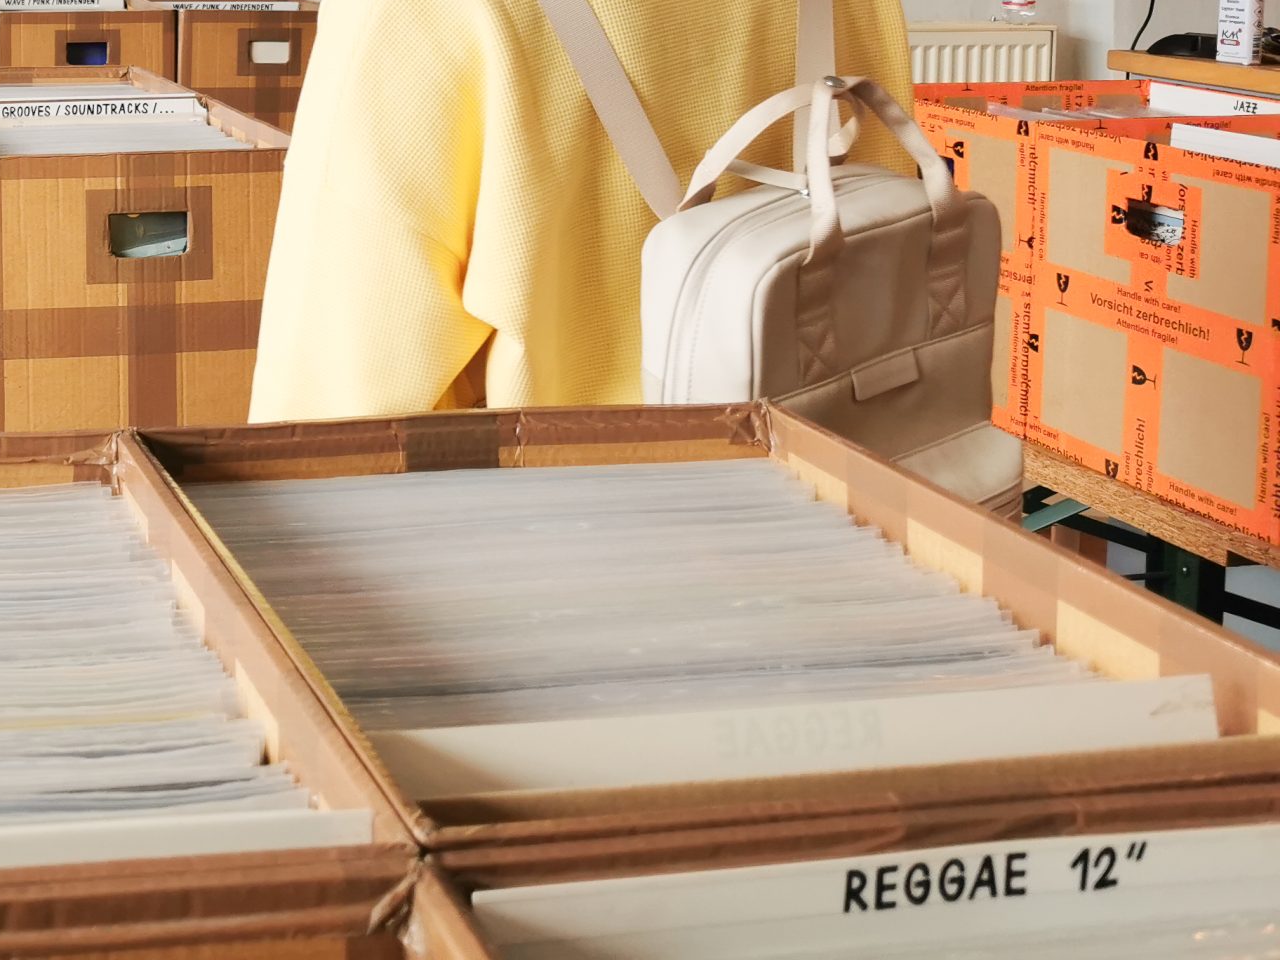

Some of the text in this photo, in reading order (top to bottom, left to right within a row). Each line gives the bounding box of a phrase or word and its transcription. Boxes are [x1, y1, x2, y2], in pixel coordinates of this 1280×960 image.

[4, 0, 25, 7] WAVE
[1059, 84, 1084, 92] fragile!
[1, 105, 51, 119] GROOVES
[64, 103, 149, 117] SOUNDTRACKS
[1233, 100, 1258, 114] JAZZ
[1204, 121, 1232, 129] fragile!
[1055, 136, 1070, 145] with
[1071, 139, 1095, 152] Handle
[1212, 168, 1234, 179] care!
[1234, 171, 1253, 183] with
[1189, 219, 1198, 279] Handle with
[1116, 287, 1182, 314] Handle with care!
[1090, 292, 1210, 341] Vorsicht zerbrechlich!
[1012, 312, 1020, 353] Attention
[1116, 318, 1178, 345] Attention fragile!
[1028, 422, 1042, 433] with
[1042, 428, 1059, 441] care!
[1260, 442, 1269, 465] with
[1258, 468, 1268, 504] Handle
[1169, 481, 1196, 500] Handle
[1197, 494, 1214, 508] with
[1216, 500, 1238, 517] care!
[843, 851, 1028, 914] REGGAE
